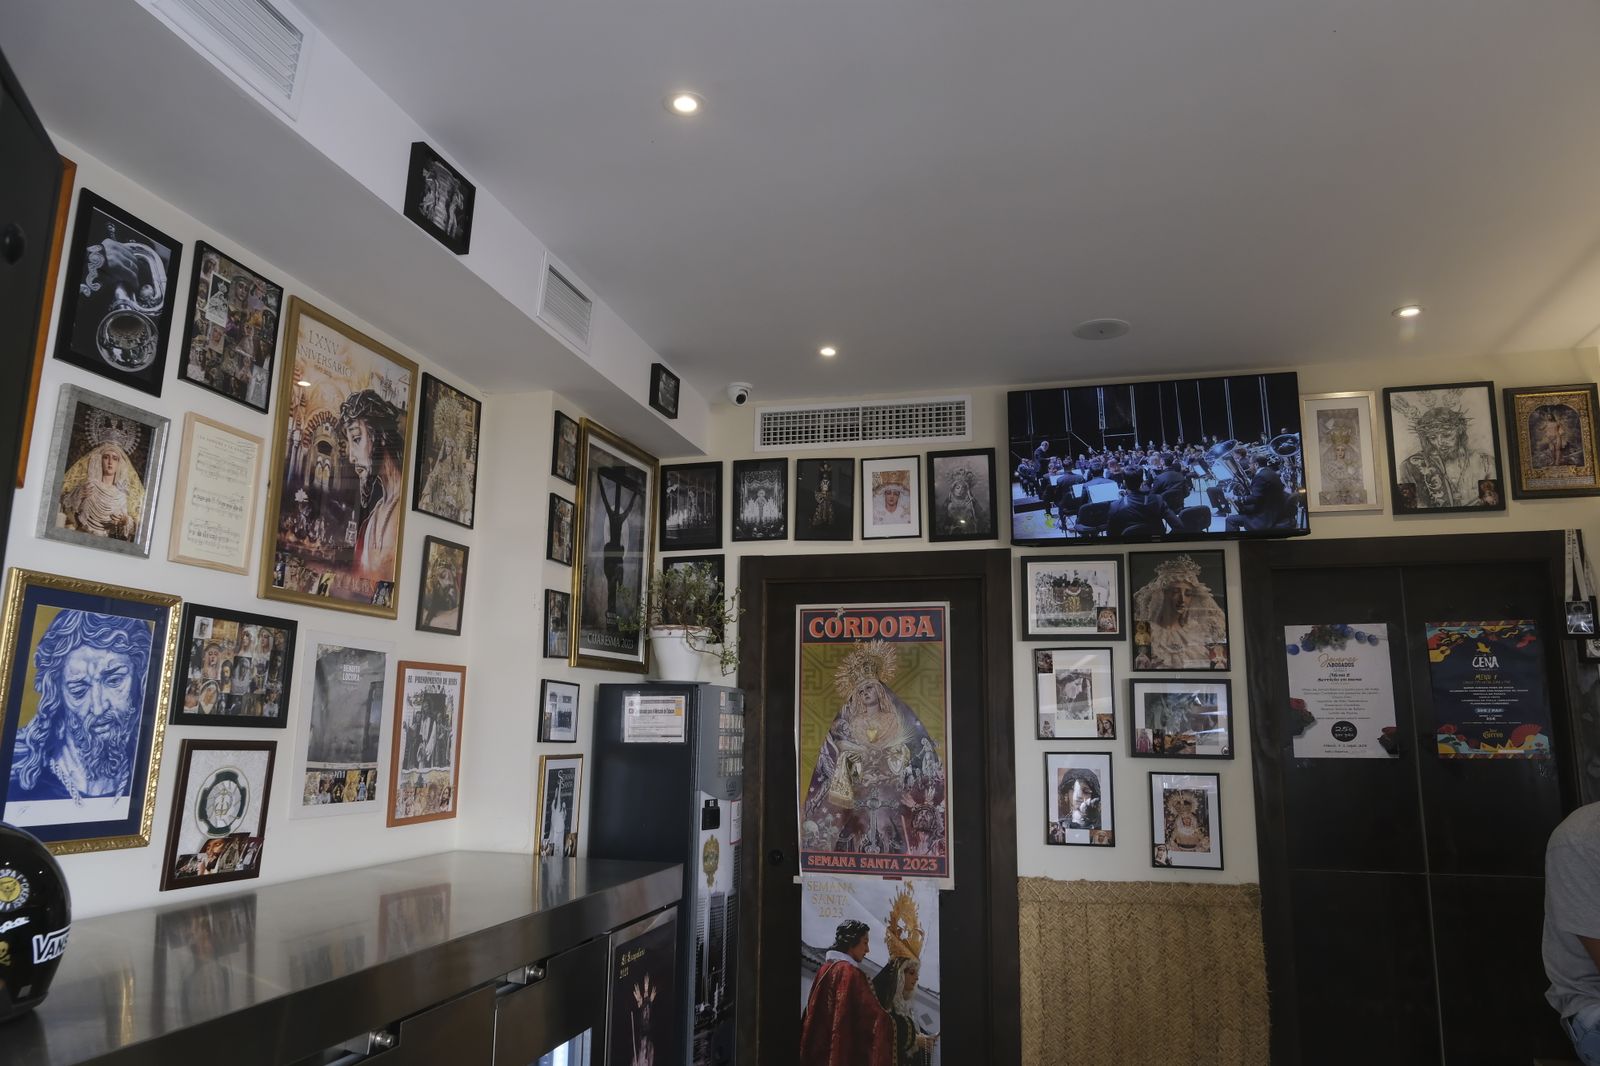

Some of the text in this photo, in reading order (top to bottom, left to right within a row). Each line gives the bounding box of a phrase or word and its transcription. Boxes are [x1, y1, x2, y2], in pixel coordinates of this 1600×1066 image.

[309, 329, 339, 355] LXXV
[587, 632, 620, 648] CUARESMA
[1472, 656, 1499, 668] CENA
[807, 855, 938, 871] SEMANA SANTA 2023
[807, 880, 856, 894] SEMANA
[811, 895, 848, 906] SANTA
[819, 907, 844, 918] 2023
